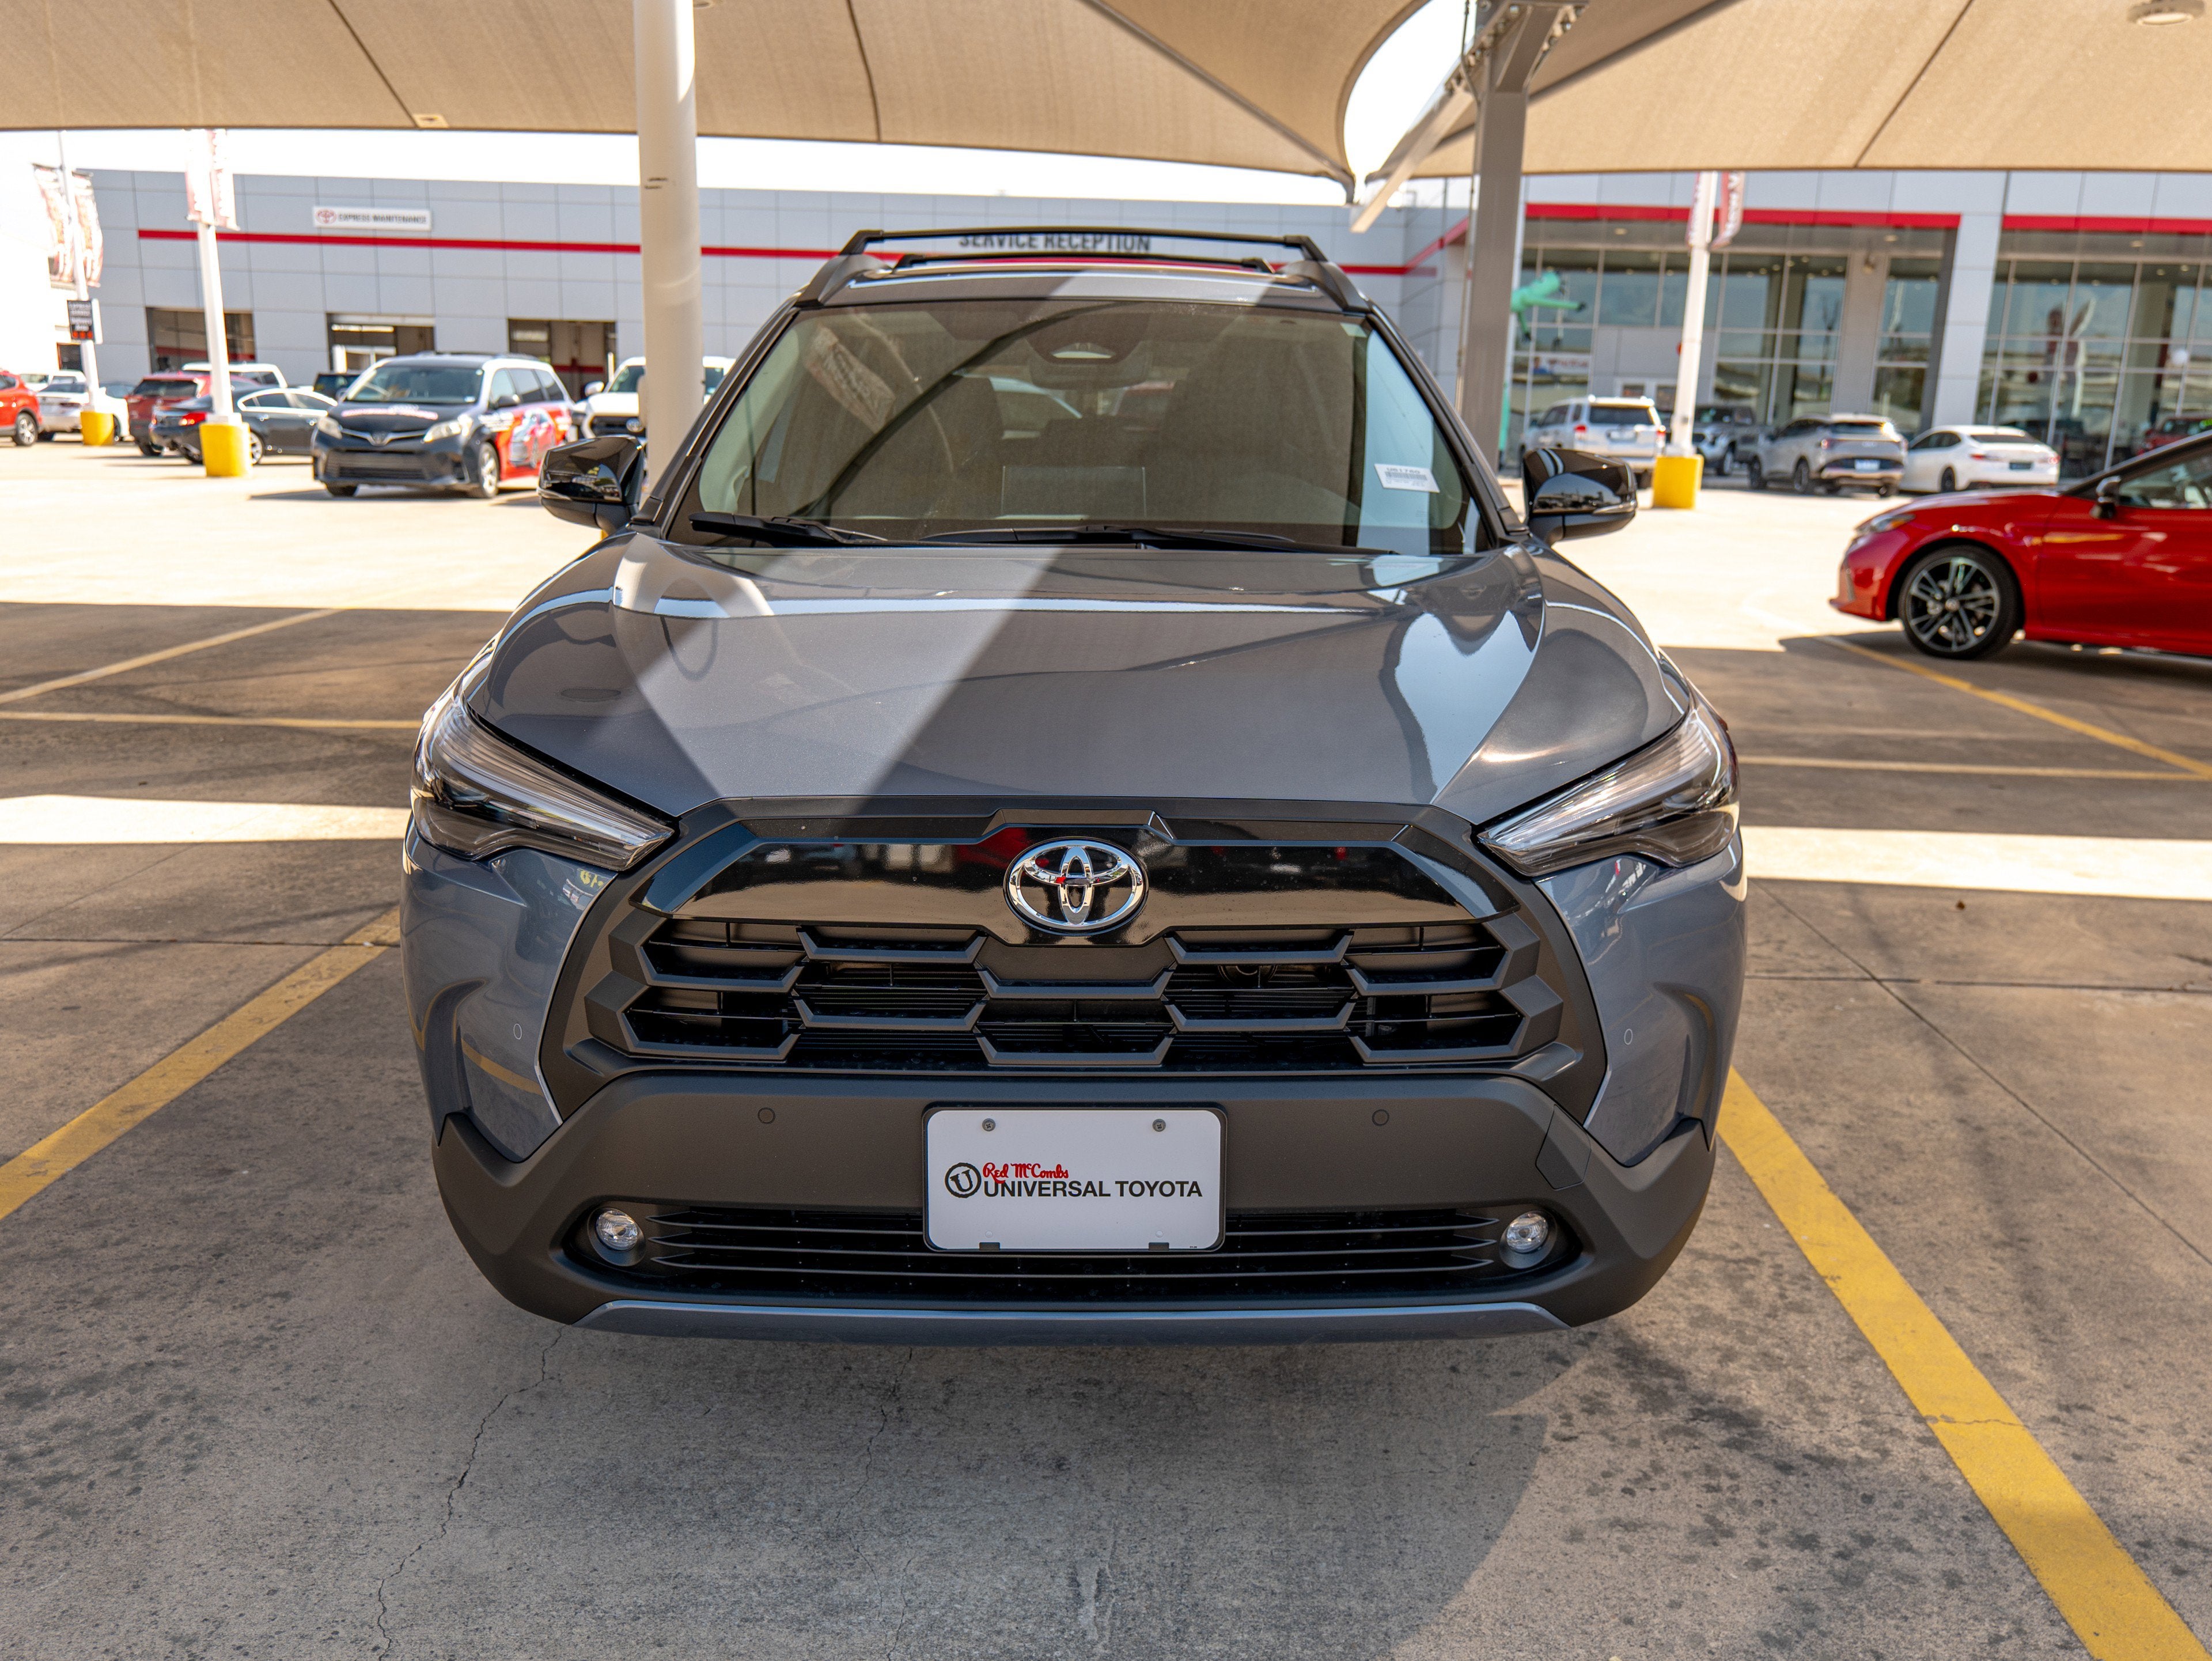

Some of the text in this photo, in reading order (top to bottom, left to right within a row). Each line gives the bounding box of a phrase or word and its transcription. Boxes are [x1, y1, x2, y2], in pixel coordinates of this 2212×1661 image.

[339, 213, 427, 224] EXPRESS MAINTENANCE
[960, 233, 1150, 252] SERVICE RECEPTION
[982, 1162, 1069, 1184] Red McCombs
[984, 1180, 1203, 1197] UNIVERSAL TOYOTA
